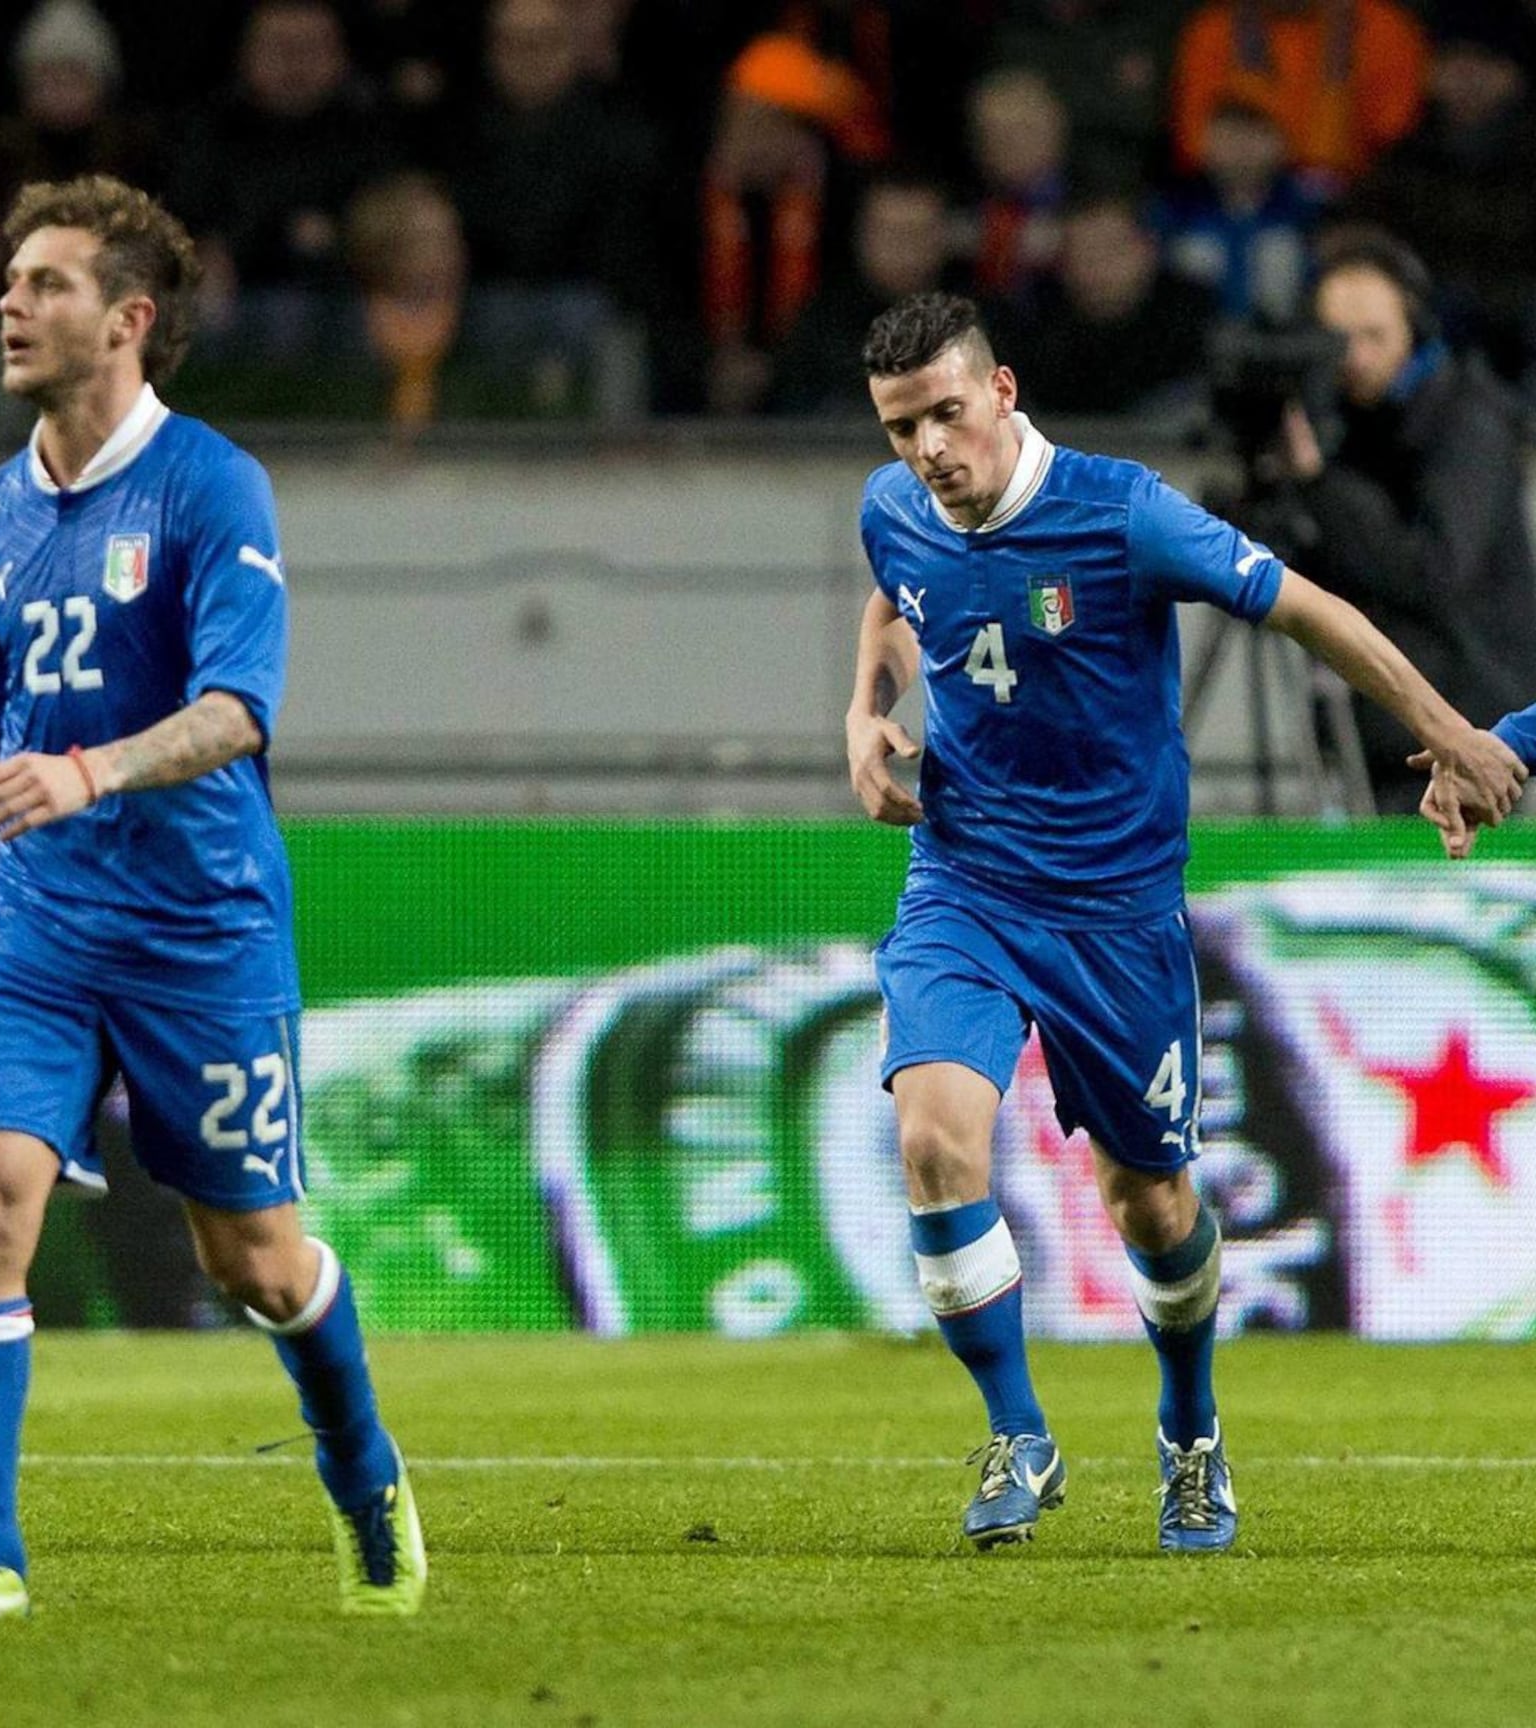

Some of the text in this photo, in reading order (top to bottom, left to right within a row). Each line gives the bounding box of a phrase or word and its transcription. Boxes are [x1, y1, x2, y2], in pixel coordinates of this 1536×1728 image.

[23, 595, 104, 694] 22
[964, 622, 1017, 703] 4
[201, 1052, 288, 1150] 22
[1144, 1039, 1186, 1122] 4
